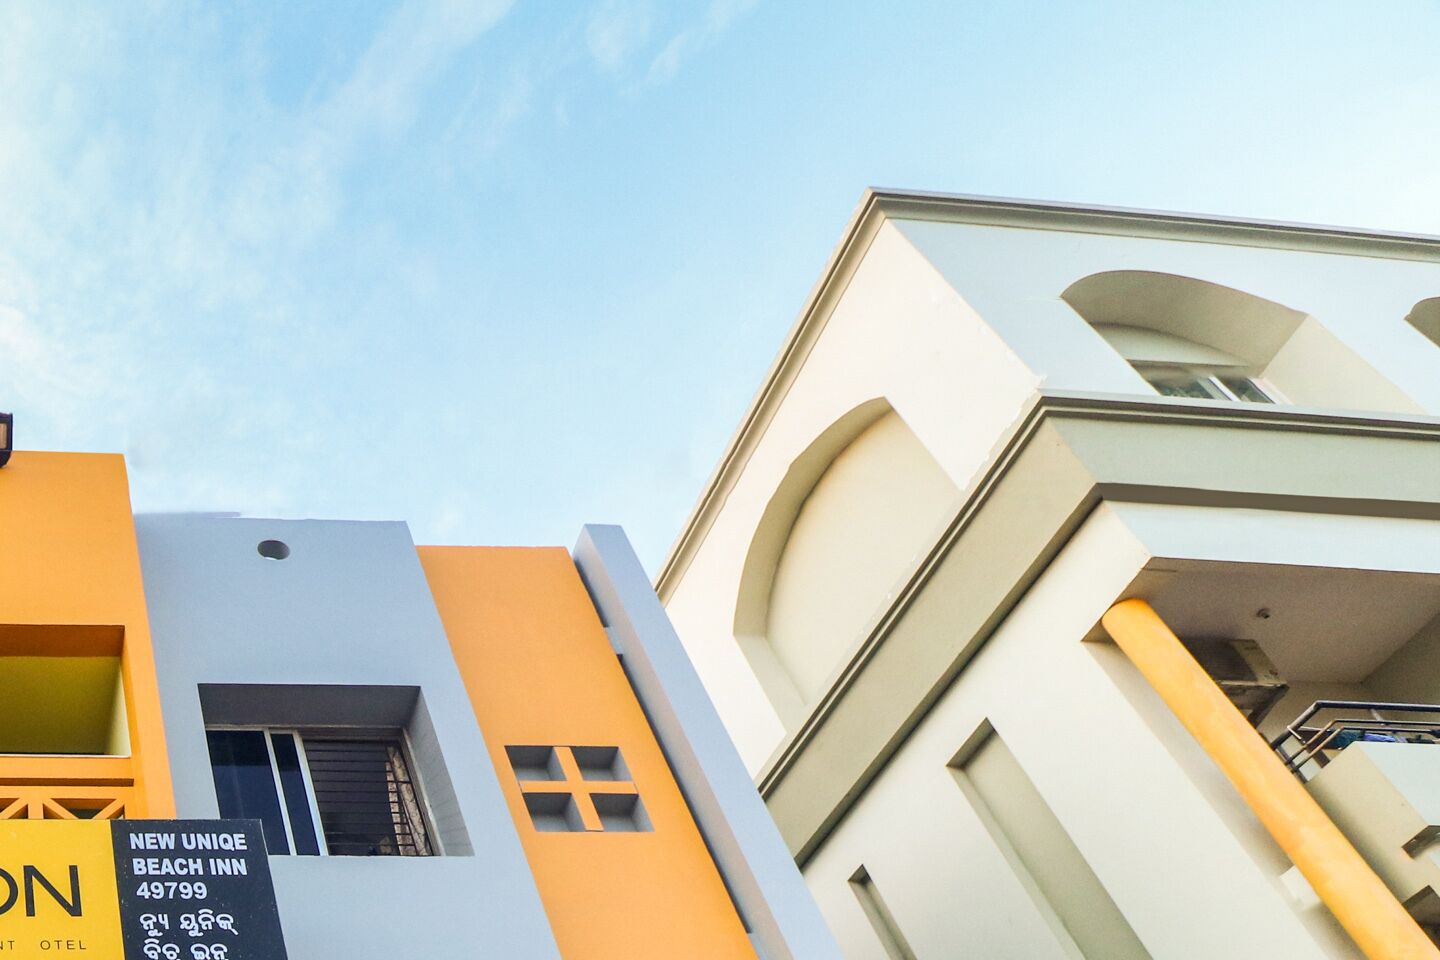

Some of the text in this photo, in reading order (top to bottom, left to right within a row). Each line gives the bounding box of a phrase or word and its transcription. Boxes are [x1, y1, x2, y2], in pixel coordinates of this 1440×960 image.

[129, 833, 248, 851] NEW UNIQE
[132, 858, 248, 875] BEACH INN
[136, 881, 208, 900] 49799
